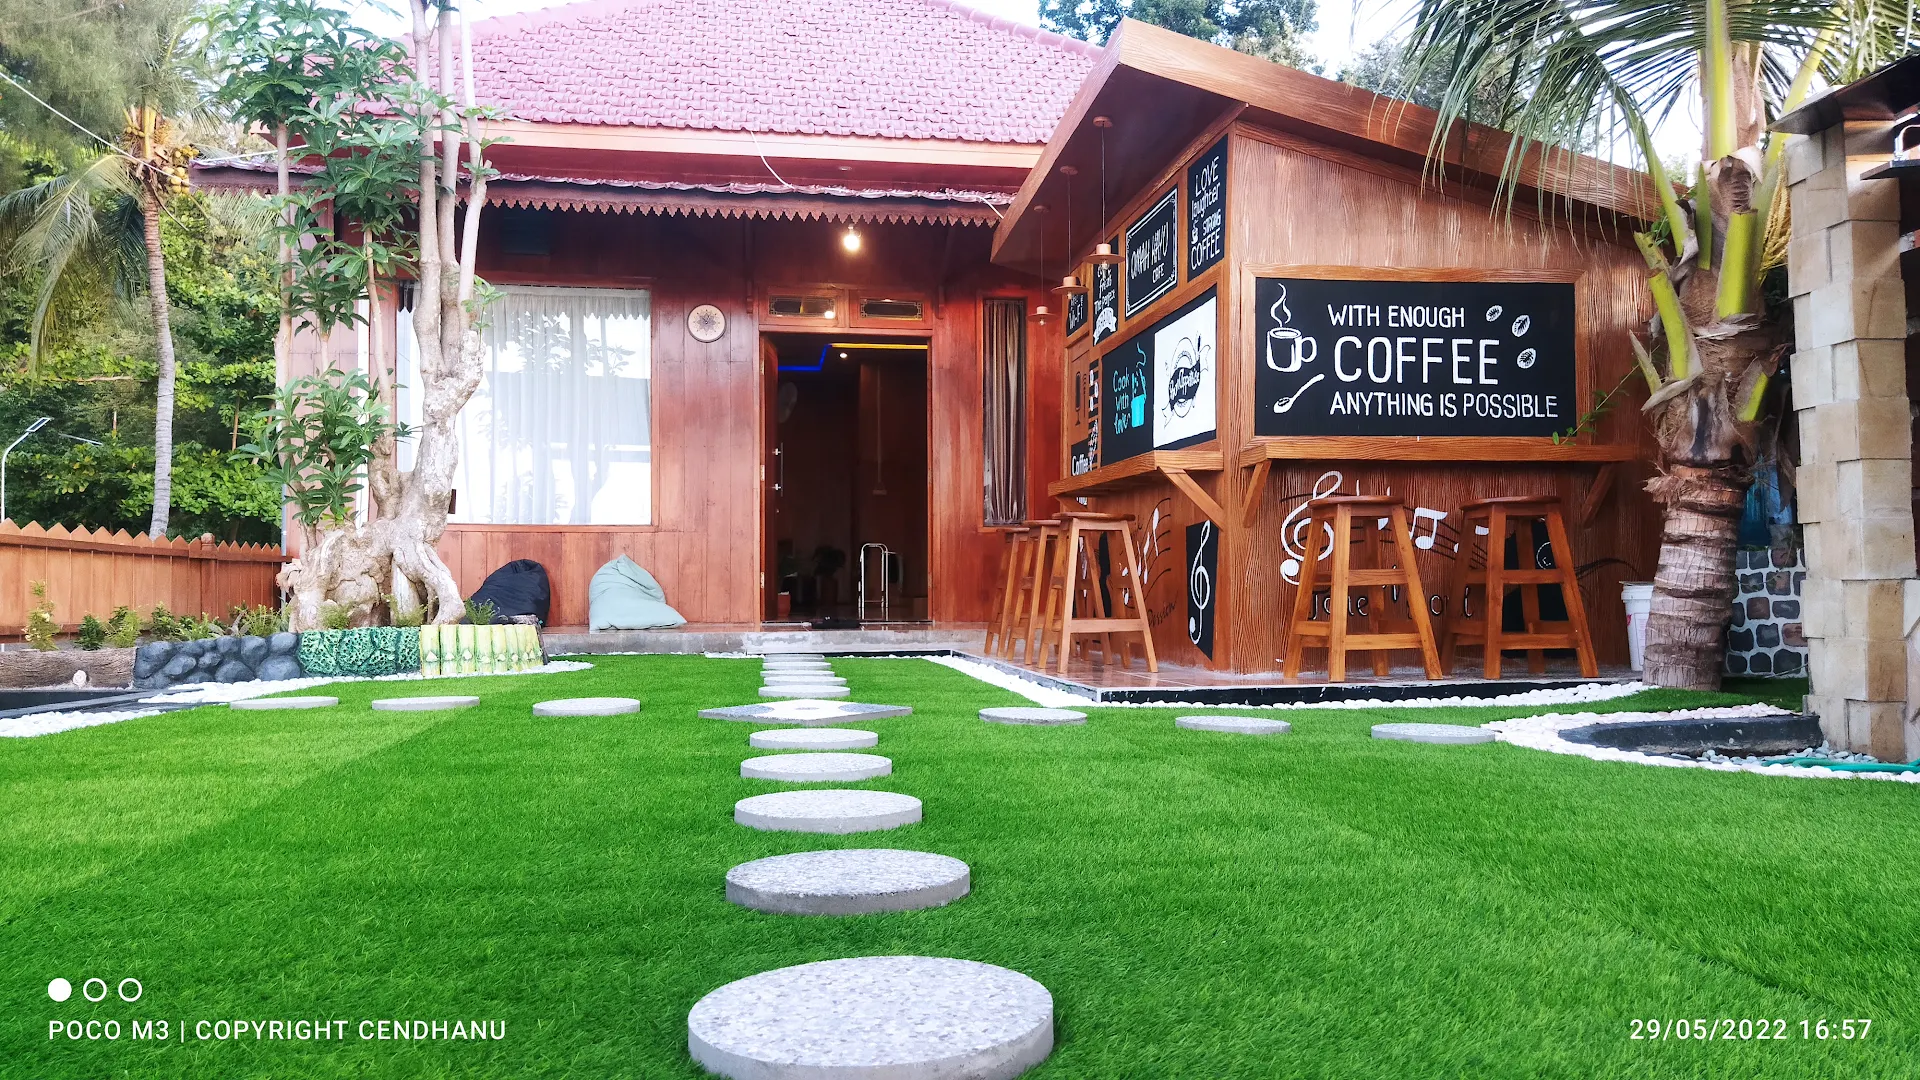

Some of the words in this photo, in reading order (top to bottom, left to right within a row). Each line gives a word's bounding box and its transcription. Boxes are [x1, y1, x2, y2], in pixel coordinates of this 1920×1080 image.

[1195, 156, 1219, 196] LOVE
[1191, 182, 1221, 220] laughter
[1202, 208, 1221, 237] STRONG
[1190, 227, 1221, 270] COFFEE
[1152, 262, 1165, 284] CAFE
[1327, 304, 1381, 328] WITH
[1388, 305, 1465, 329] ENOUGH
[1334, 335, 1500, 385] COFFEE
[1112, 367, 1130, 393] Cook
[1115, 393, 1129, 411] with
[1329, 391, 1433, 417] ANYTHING
[1439, 394, 1457, 418] IS
[1463, 393, 1559, 419] POSSIBLE
[1071, 453, 1088, 477] Coffee
